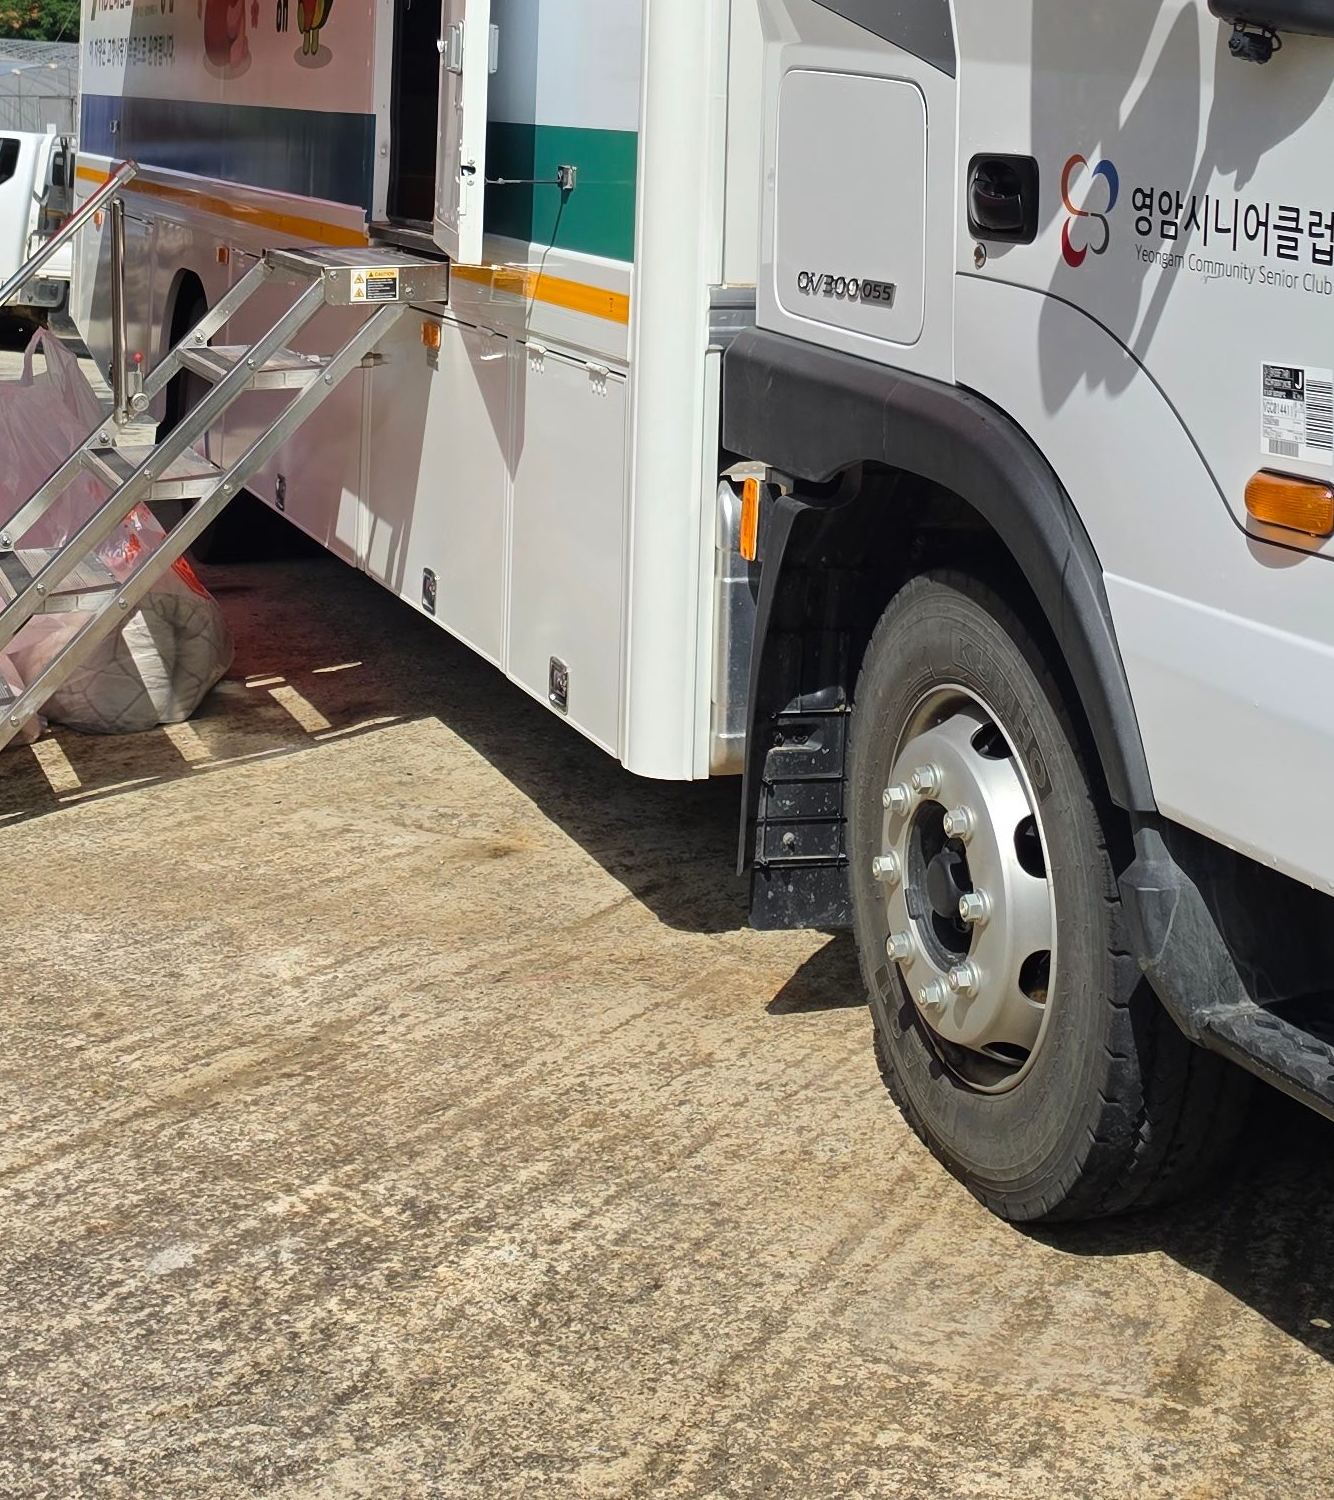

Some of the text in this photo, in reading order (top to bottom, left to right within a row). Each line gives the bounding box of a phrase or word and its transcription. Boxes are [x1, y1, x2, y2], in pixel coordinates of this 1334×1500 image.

[1135, 243, 1333, 296] Yeongam Community Senior Club
[862, 282, 892, 301] 055
[1294, 371, 1303, 390] J
